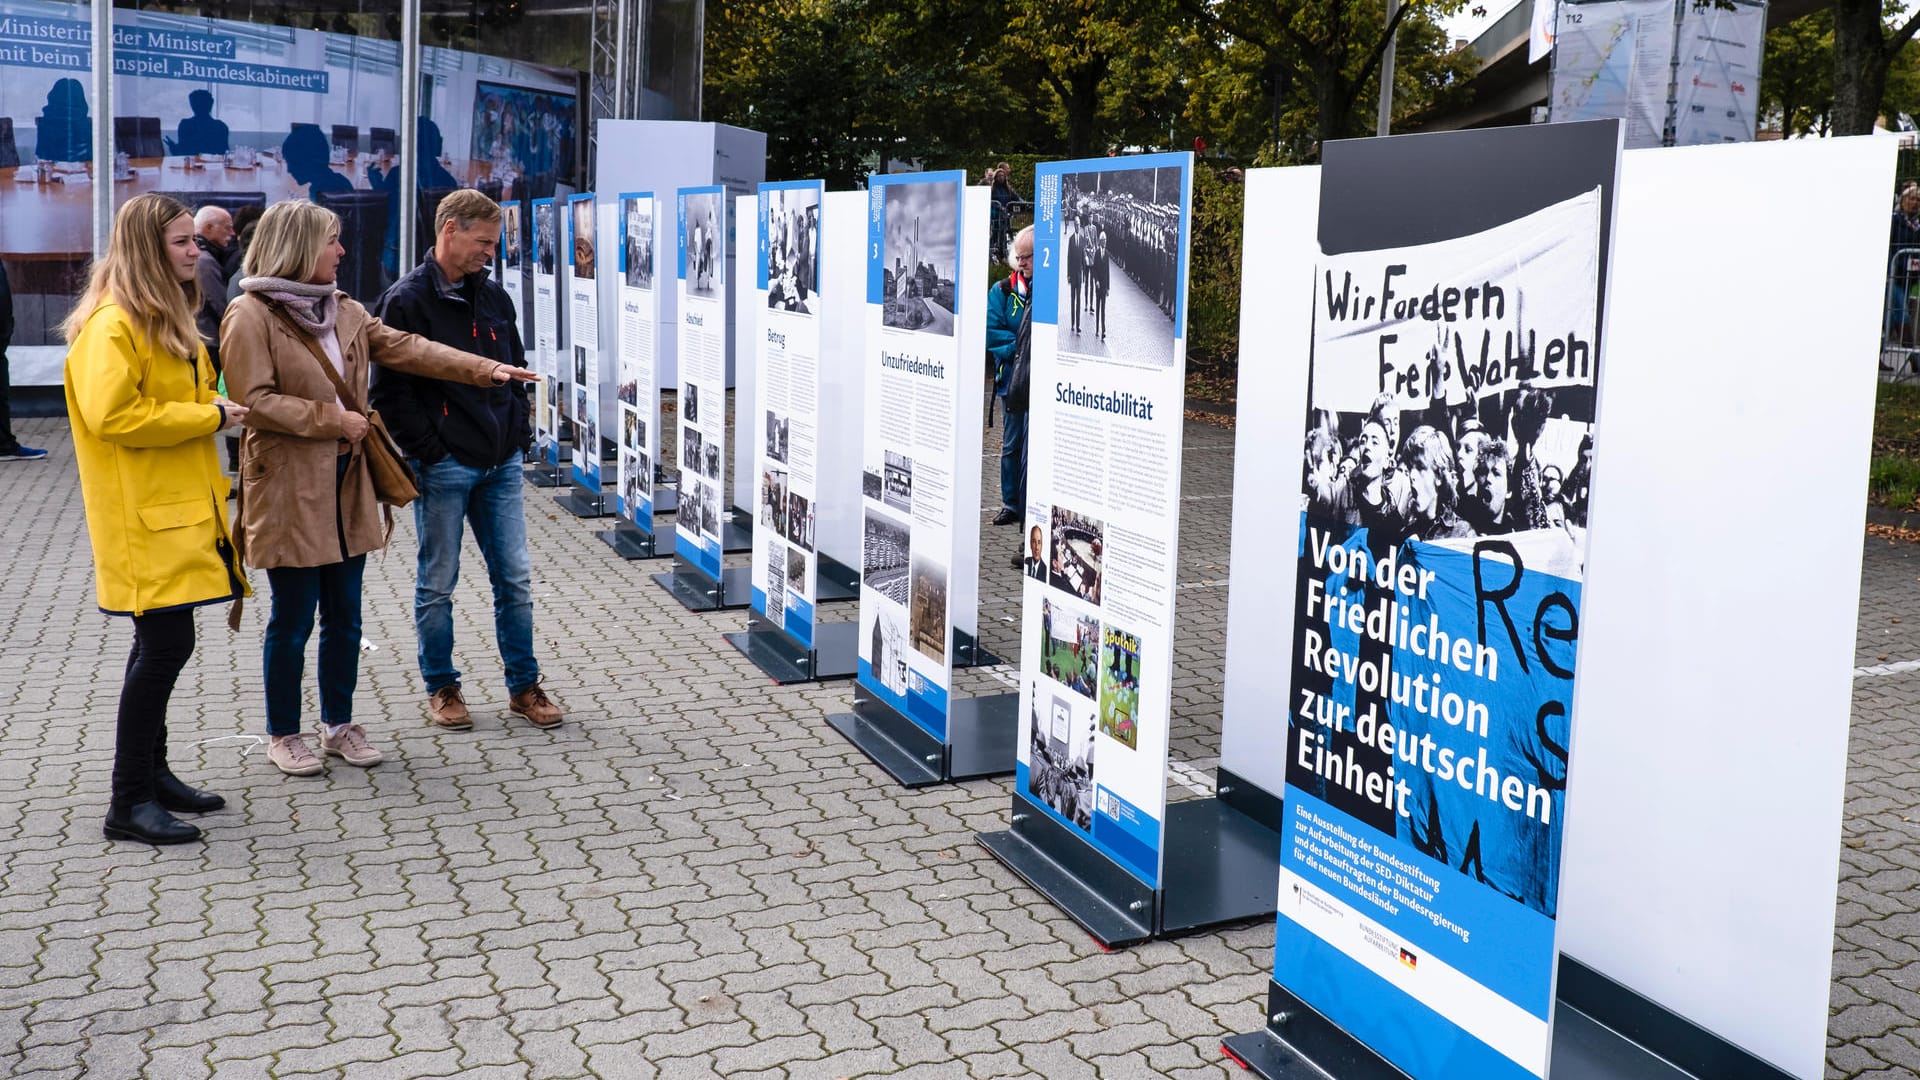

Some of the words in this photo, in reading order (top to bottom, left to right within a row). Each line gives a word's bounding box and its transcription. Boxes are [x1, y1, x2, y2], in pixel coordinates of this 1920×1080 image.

[1566, 14, 1583, 24] T12
[32, 47, 80, 67] beim
[148, 32, 231, 55] Minister?
[760, 238, 766, 252] 4
[872, 243, 878, 259] 3
[1043, 247, 1050, 268] 2
[1326, 269, 1375, 321] Wir
[1380, 264, 1505, 322] Fordern
[767, 327, 785, 349] Betrug
[881, 350, 944, 379] Unzufriedenheit
[1056, 382, 1153, 420] Scheinstabilität
[1309, 527, 1368, 582] Von
[1375, 545, 1435, 600] der
[1105, 628, 1138, 654] Sputnik
[1306, 578, 1498, 682] Friedlichen
[1303, 628, 1490, 738] Revolution
[1298, 728, 1412, 818] Einheit
[1299, 688, 1351, 733] zur
[1356, 703, 1551, 825] deutschen
[1295, 821, 1308, 833] zur
[1308, 827, 1360, 865] Aufarbeitung
[1360, 855, 1374, 870] der
[1375, 863, 1434, 903] SED-Diktatur
[1296, 804, 1312, 821] Eine
[1313, 814, 1357, 848] Ausstellung
[1358, 837, 1372, 853] der
[1373, 845, 1440, 893] Bundesstiftung
[1294, 847, 1306, 862] für
[1306, 855, 1318, 869] die
[1318, 864, 1342, 883] neuen
[1343, 876, 1399, 916] Bundesländer
[1294, 835, 1309, 849] und
[1309, 842, 1323, 857] des
[1323, 849, 1376, 888] Beauftragten
[1377, 880, 1392, 896] der
[1393, 888, 1470, 943] Bundesregierung
